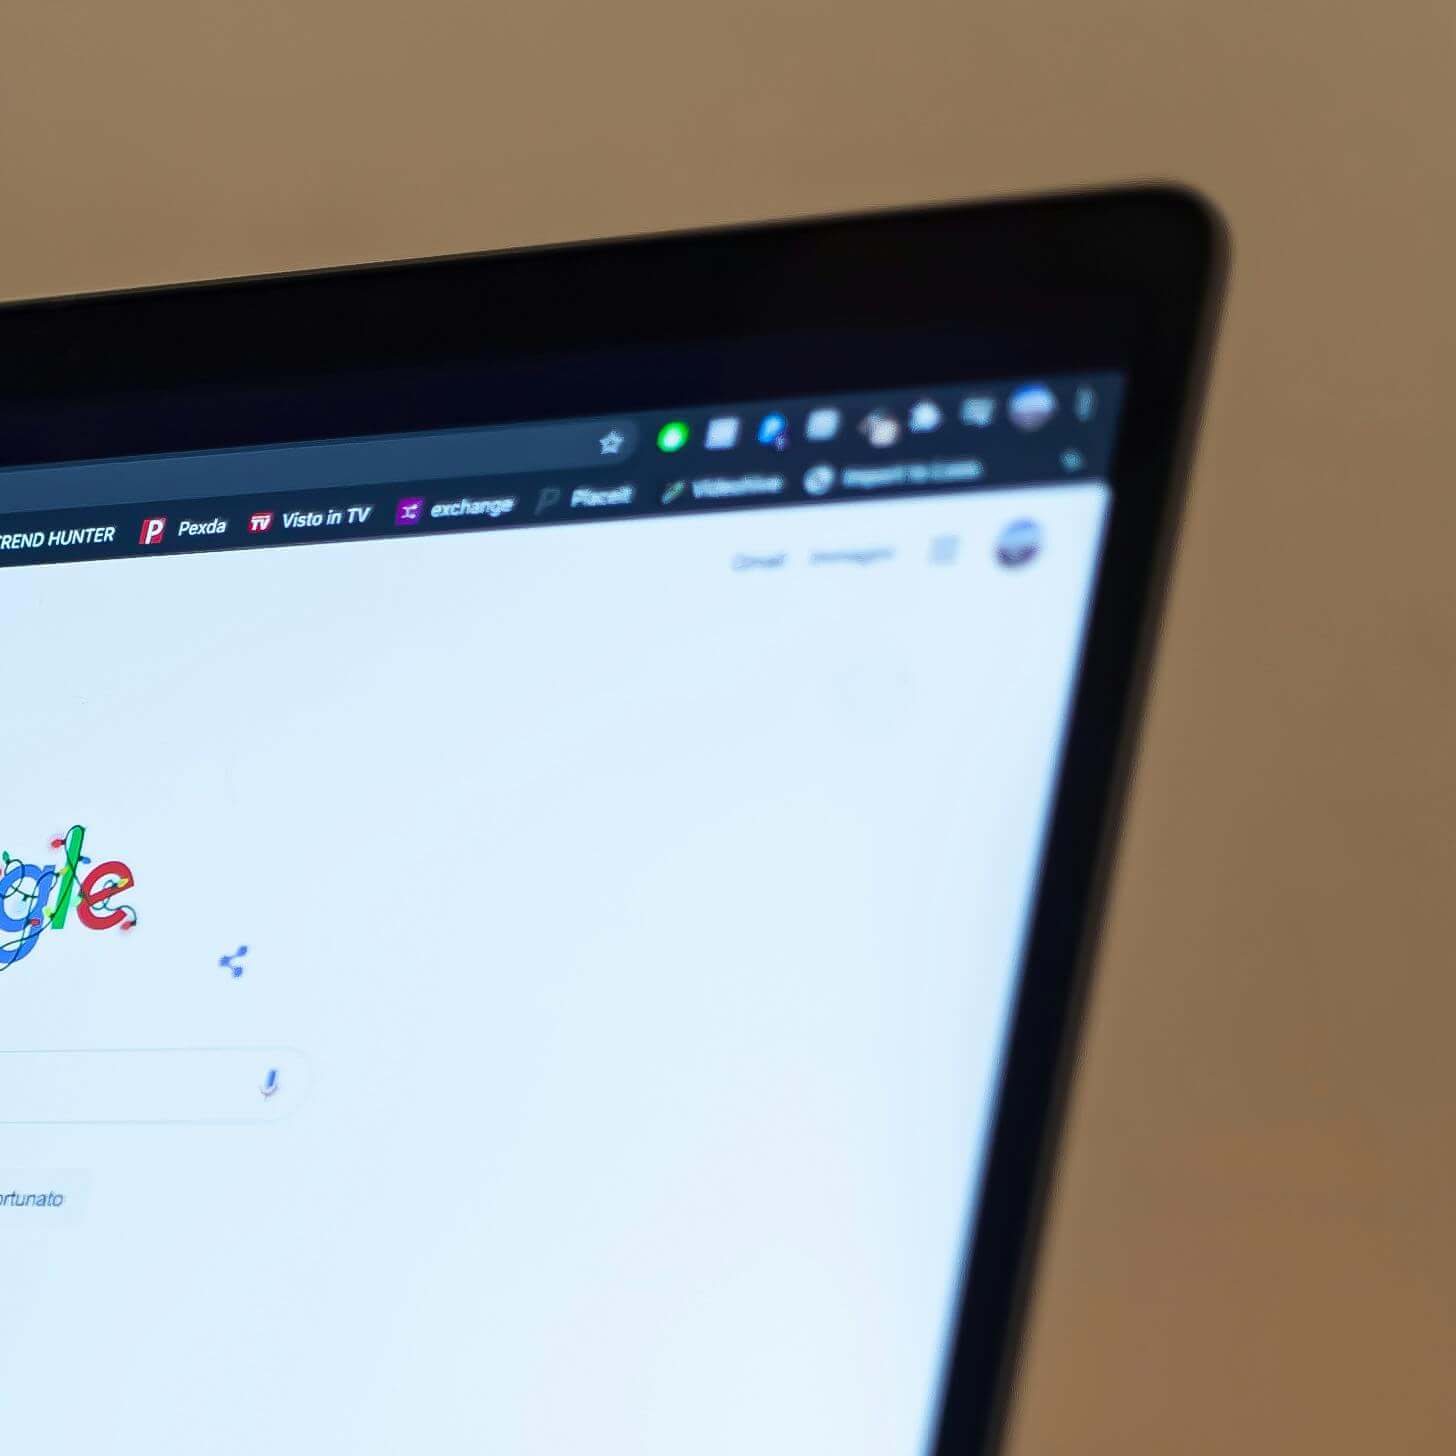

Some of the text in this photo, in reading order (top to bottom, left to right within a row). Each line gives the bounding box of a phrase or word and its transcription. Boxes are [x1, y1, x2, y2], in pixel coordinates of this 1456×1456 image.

[282, 506, 372, 529] Visto in TV
[430, 497, 515, 518] exchange
[48, 526, 116, 547] HUNTER
[178, 517, 227, 537] Pexda
